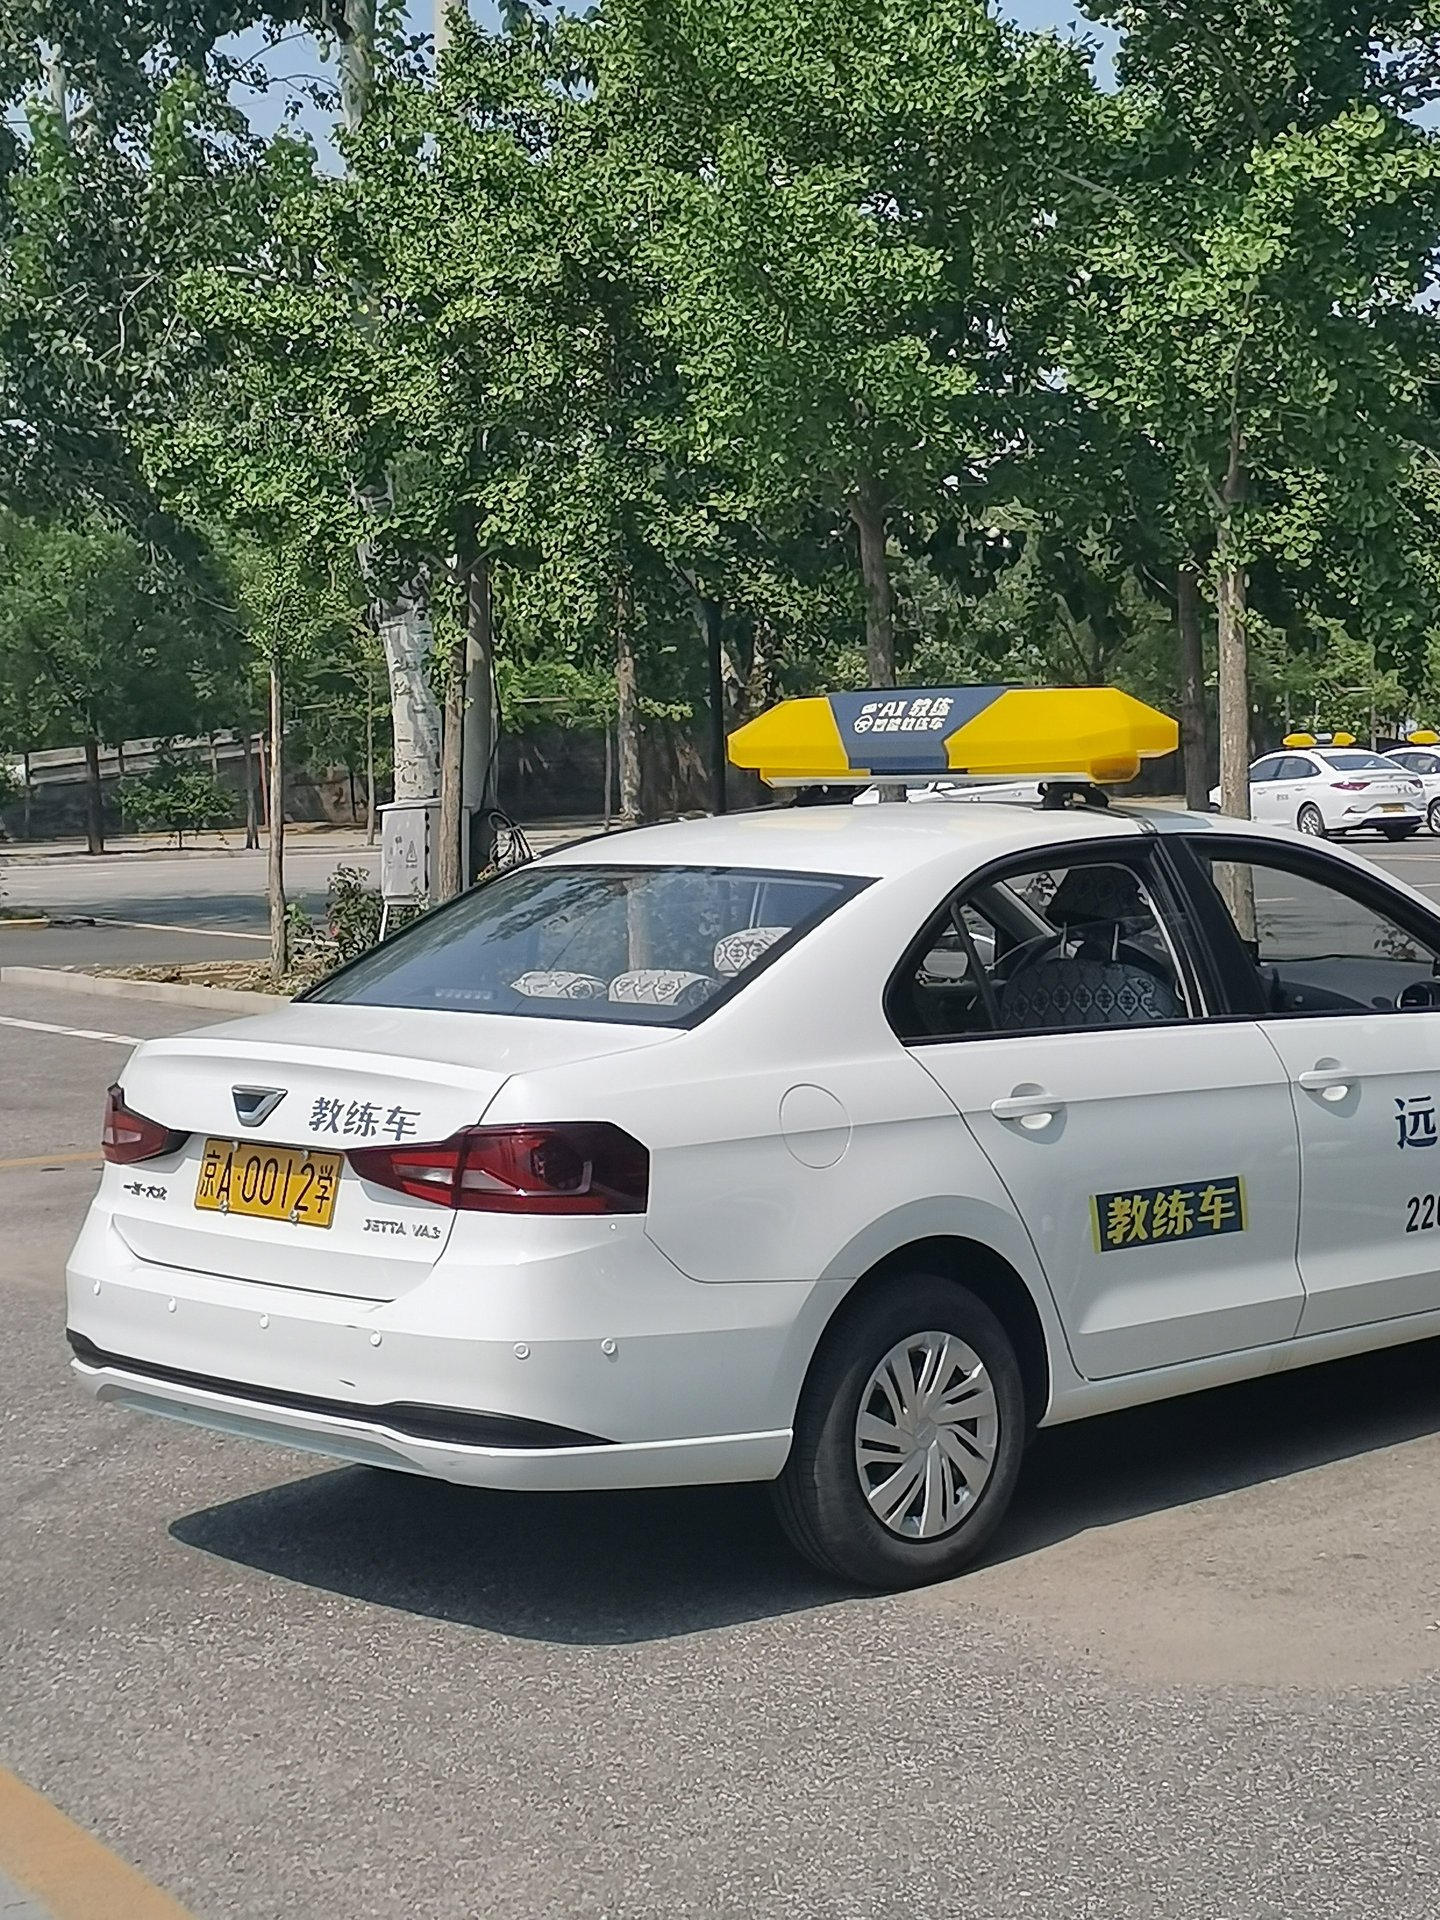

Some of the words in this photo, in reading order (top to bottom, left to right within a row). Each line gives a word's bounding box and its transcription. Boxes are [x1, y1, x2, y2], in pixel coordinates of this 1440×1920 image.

[308, 1097, 422, 1142] 教练车
[1394, 1095, 1439, 1150] 远
[363, 1219, 407, 1236] JETTA
[1107, 1185, 1237, 1245] 教练车
[1405, 1194, 1440, 1233] 22
